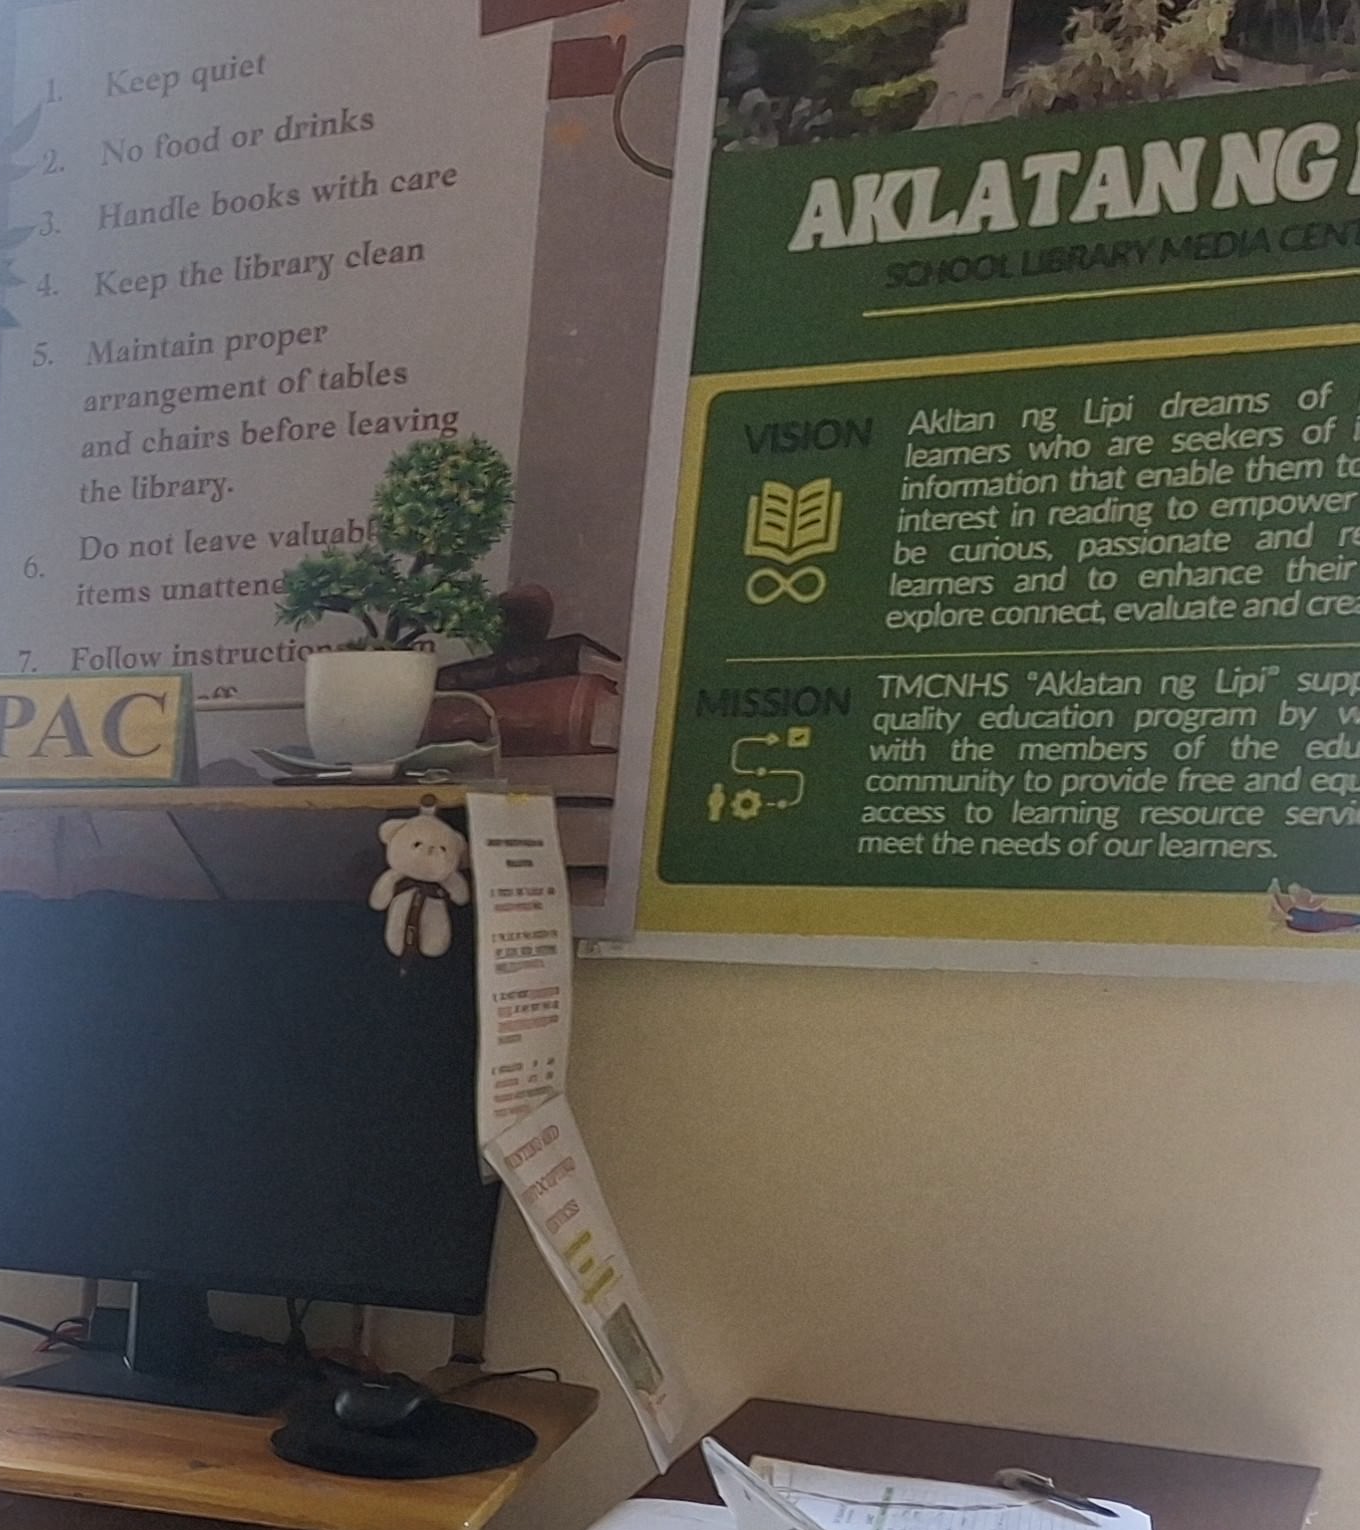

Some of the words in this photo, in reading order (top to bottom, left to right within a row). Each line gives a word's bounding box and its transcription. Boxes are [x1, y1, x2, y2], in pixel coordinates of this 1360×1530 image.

[46, 78, 63, 104] 1.
[106, 68, 179, 98] Keep
[192, 53, 266, 93] quiet
[42, 149, 65, 176] 2.
[100, 140, 143, 166] No
[155, 126, 220, 159] food
[231, 126, 264, 149] or
[274, 107, 374, 143] drinks
[39, 211, 62, 237] 3.
[98, 194, 201, 230] Handle
[212, 182, 301, 217] books
[312, 170, 379, 201] with
[391, 167, 458, 193] care
[787, 137, 1206, 252] AKLATAN
[1212, 122, 1341, 210] NG
[37, 274, 59, 297] 4.
[95, 269, 167, 300] Keep
[180, 261, 223, 288] the
[233, 250, 334, 281] library
[345, 239, 425, 269] clean
[884, 254, 1012, 290] SCHOOL
[1021, 239, 1155, 277] LIBRARY
[1160, 229, 1270, 265] MEDIA
[32, 342, 54, 367] 5.
[86, 331, 215, 366] Maintain
[225, 323, 329, 361] proper
[83, 374, 267, 415] arrangement
[277, 368, 311, 395] of
[319, 361, 408, 391] tables
[1021, 407, 1058, 433] ng
[1084, 395, 1134, 428] Lipi
[1161, 391, 1270, 419] dreams
[1297, 382, 1333, 410] of
[81, 431, 131, 459] and
[142, 425, 230, 454] chairs
[241, 417, 336, 446] before
[347, 408, 460, 439] leaving
[744, 418, 873, 454] VISION
[904, 443, 1011, 468] learners
[1029, 434, 1090, 460] who
[1108, 434, 1154, 457] are
[1171, 422, 1283, 453] seekers
[1302, 417, 1337, 445] of
[80, 480, 122, 503] the
[132, 473, 234, 503] library.
[901, 469, 1057, 500] information
[1070, 466, 1127, 493] that
[1136, 459, 1234, 488] enable
[1245, 455, 1323, 483] them
[897, 505, 999, 533] interest
[1011, 502, 1035, 527] in
[1048, 497, 1154, 527] reading
[1167, 497, 1198, 520] to
[1210, 491, 1358, 521] empower
[23, 555, 45, 578] 6.
[79, 536, 119, 561] Do
[128, 533, 173, 558] not
[184, 529, 257, 555] leave
[893, 540, 927, 565] be
[950, 536, 1053, 562] curious,
[1078, 529, 1232, 562] passionate
[1255, 521, 1314, 550] and
[76, 577, 150, 606] items
[890, 573, 993, 597] learners
[1014, 566, 1066, 593] and
[1088, 567, 1117, 590] to
[1138, 561, 1263, 589] enhance
[1286, 555, 1358, 583] their
[885, 602, 984, 633] explore
[991, 600, 1106, 628] connect,
[1114, 594, 1237, 622] evaluate
[1243, 590, 1300, 618] and
[18, 650, 38, 673] 7.
[71, 645, 162, 672] Follow
[697, 686, 852, 718] MISSION
[878, 671, 1009, 699] TMCNHS
[1160, 674, 1197, 700] ng
[872, 704, 962, 735] quality
[980, 703, 1114, 731] education
[1134, 707, 1257, 733] program
[1279, 700, 1317, 731] by
[870, 737, 926, 762] with
[951, 737, 995, 762] the
[1019, 736, 1148, 761] members
[1173, 735, 1207, 760] of
[1231, 734, 1280, 759] the
[865, 768, 1014, 796] community
[1023, 770, 1052, 792] to
[1061, 767, 1168, 797] provide
[1178, 766, 1235, 792] free
[1244, 766, 1302, 792] and
[861, 804, 945, 825] access
[965, 801, 993, 824] to
[1011, 799, 1120, 829] learning
[1140, 805, 1264, 825] resource
[858, 832, 924, 854] meet
[932, 831, 975, 855] the
[980, 831, 1061, 856] needs
[1068, 831, 1099, 856] of
[1103, 836, 1153, 857] our
[1158, 832, 1278, 858] learners.
